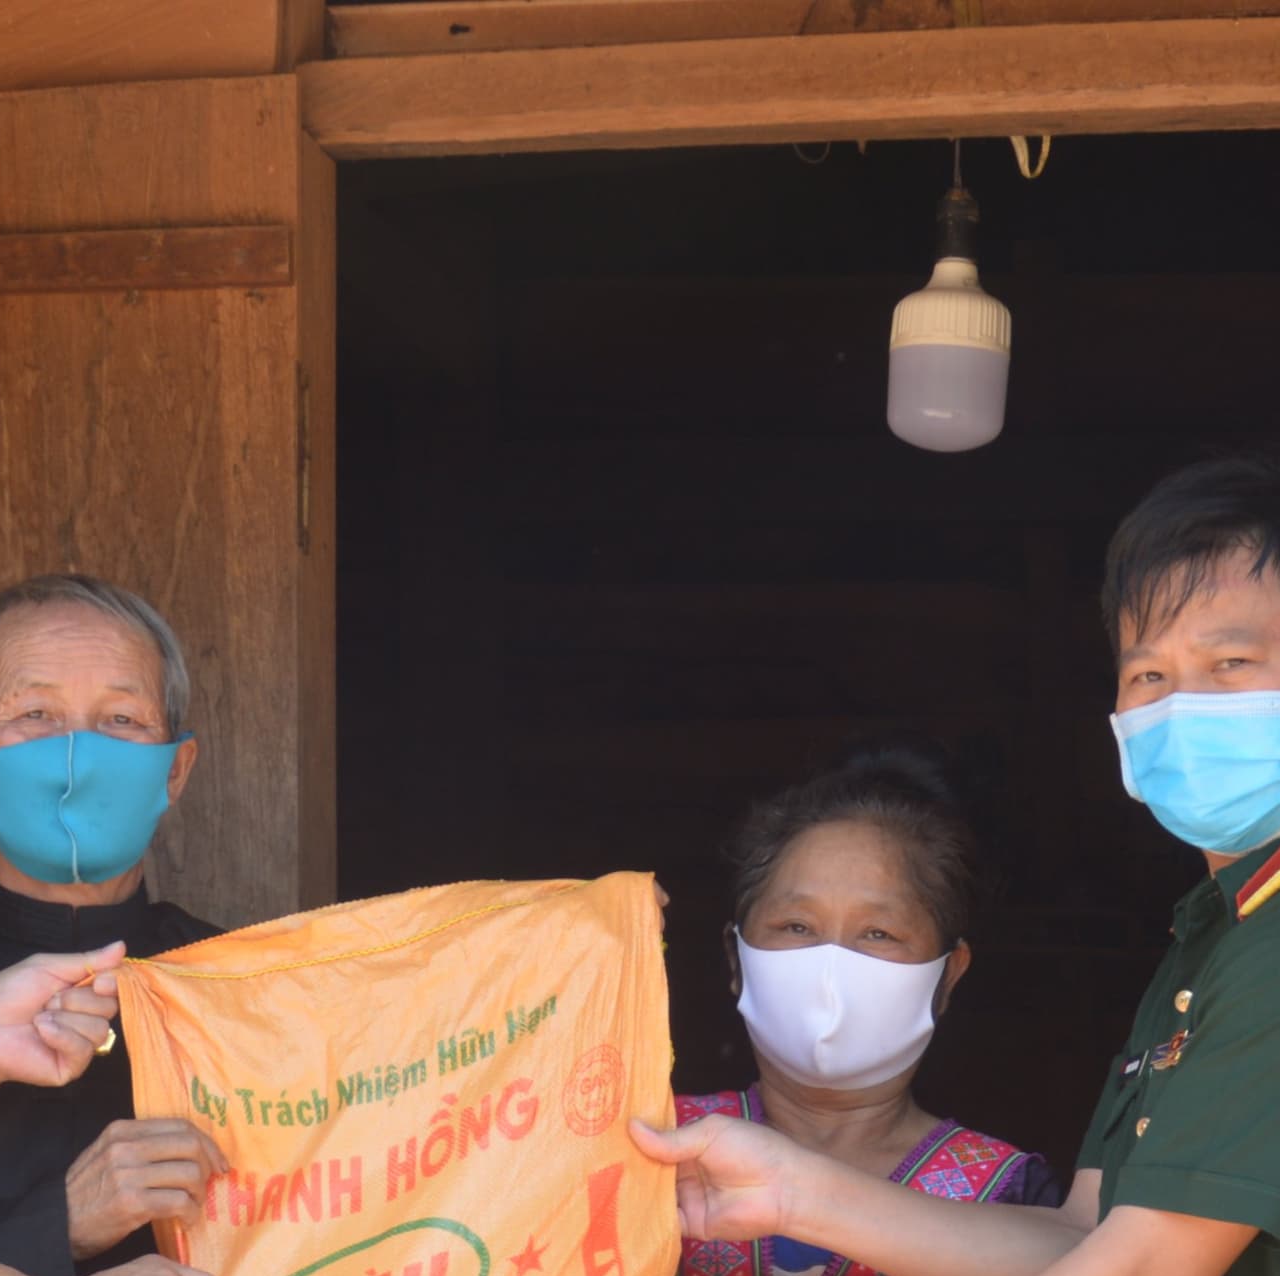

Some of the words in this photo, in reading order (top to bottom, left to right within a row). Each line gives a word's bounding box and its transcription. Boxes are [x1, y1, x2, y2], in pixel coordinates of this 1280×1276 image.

[235, 1088, 329, 1126] Trách
[336, 1059, 427, 1111] Nhiệm
[437, 1027, 496, 1077] Hữu
[386, 1077, 540, 1201] HỒNG
